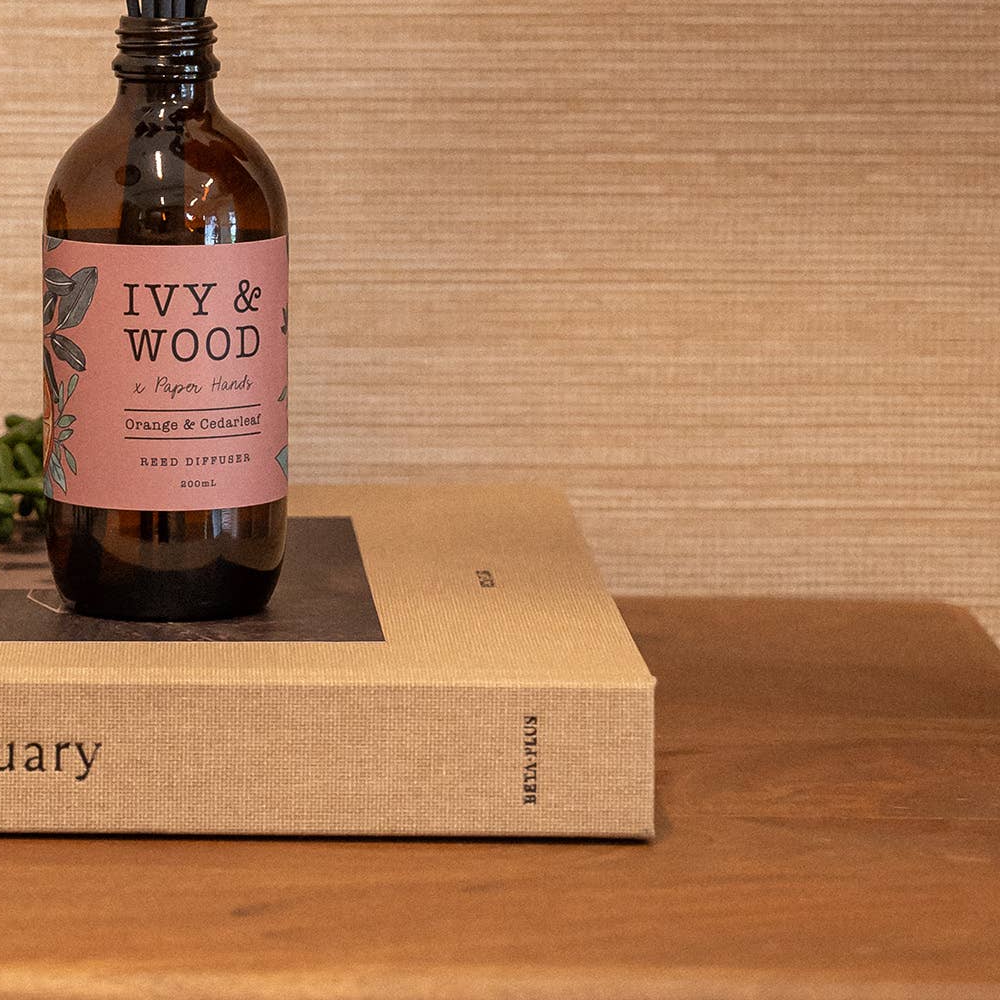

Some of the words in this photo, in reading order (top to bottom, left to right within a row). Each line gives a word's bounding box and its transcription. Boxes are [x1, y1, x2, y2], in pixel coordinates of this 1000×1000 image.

[123, 282, 217, 317] IVY
[233, 279, 261, 313] &
[123, 325, 260, 362] WOOD
[154, 375, 202, 400] Paper
[211, 374, 253, 392] Hands
[125, 418, 178, 433] Orange
[183, 418, 196, 430] &
[200, 413, 261, 430] Cedarleaf
[140, 457, 179, 467] REED
[185, 453, 251, 466] DIFFUSER
[180, 479, 217, 488] 200mL
